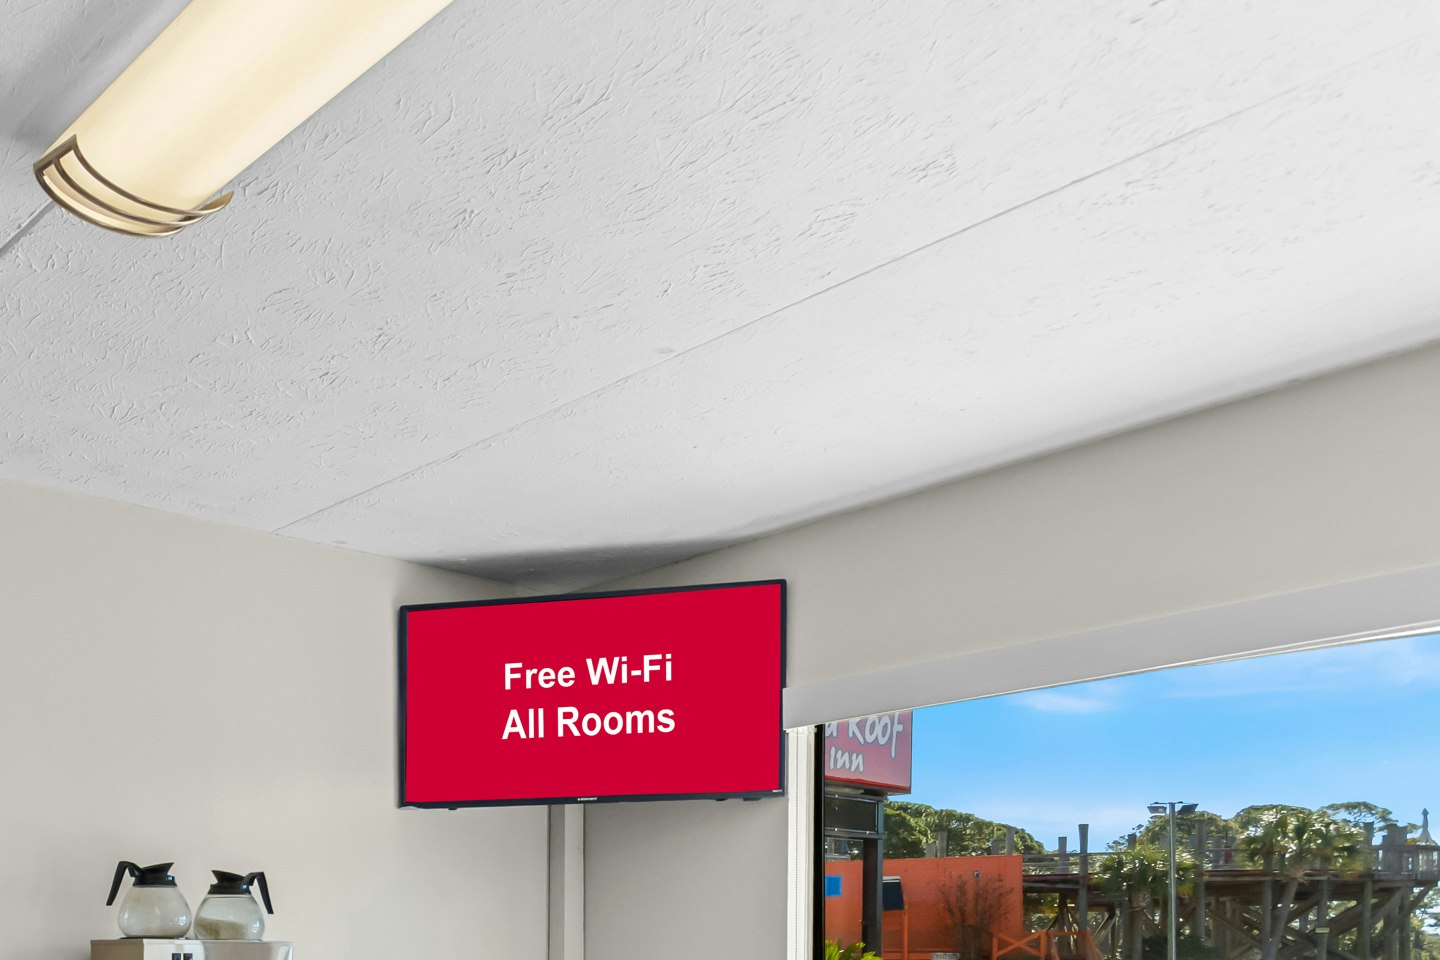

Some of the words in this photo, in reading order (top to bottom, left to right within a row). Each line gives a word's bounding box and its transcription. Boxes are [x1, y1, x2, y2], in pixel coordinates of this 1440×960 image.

[504, 662, 576, 690] Free
[585, 653, 672, 686] Wi-Fi
[501, 709, 545, 740] All
[557, 706, 676, 738] Rooms
